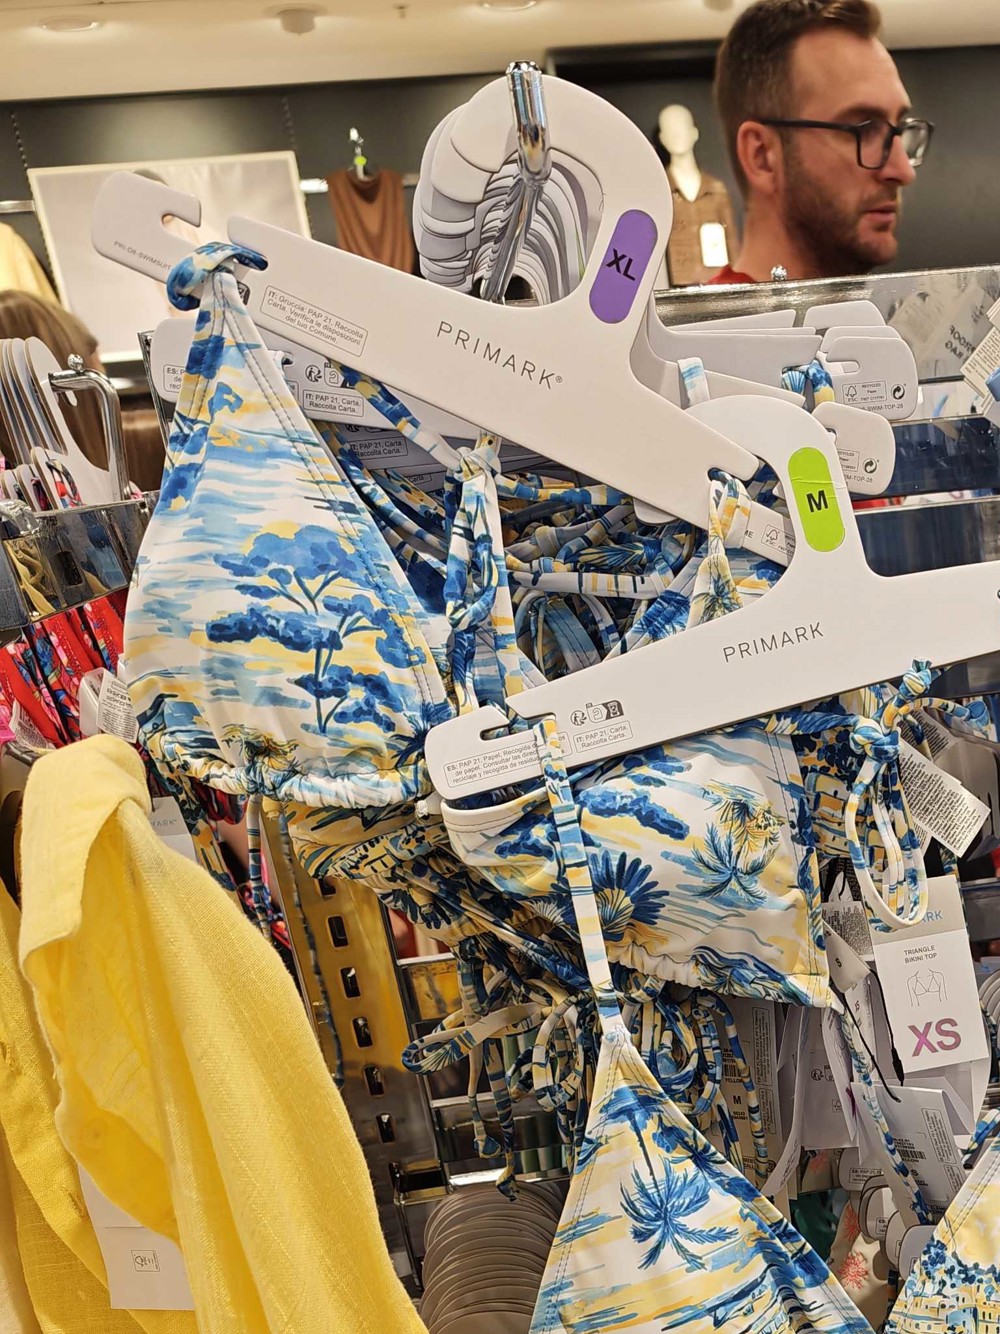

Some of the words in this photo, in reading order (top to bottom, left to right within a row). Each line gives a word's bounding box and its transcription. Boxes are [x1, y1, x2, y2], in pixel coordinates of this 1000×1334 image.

[606, 248, 636, 282] XL
[306, 306, 324, 320] PAP
[333, 317, 365, 340] Raccolta
[315, 394, 329, 403] PAP
[308, 401, 340, 412] Raccolta
[806, 489, 829, 513] M
[723, 622, 824, 663] PRIMARK
[576, 735, 585, 744] IT:
[584, 732, 600, 741] PAP
[581, 737, 608, 748] Raccolta
[446, 764, 458, 772] ES:
[458, 760, 472, 769] PAP
[503, 744, 532, 758] Recogida
[482, 758, 511, 770] Consultar
[452, 772, 478, 784] reciclaje
[482, 764, 509, 778] recogida
[904, 944, 936, 956] TRIANGLE
[904, 955, 924, 964] BIKINI
[925, 952, 938, 961] TOP
[907, 1017, 962, 1058] XS
[732, 1095, 742, 1106] M
